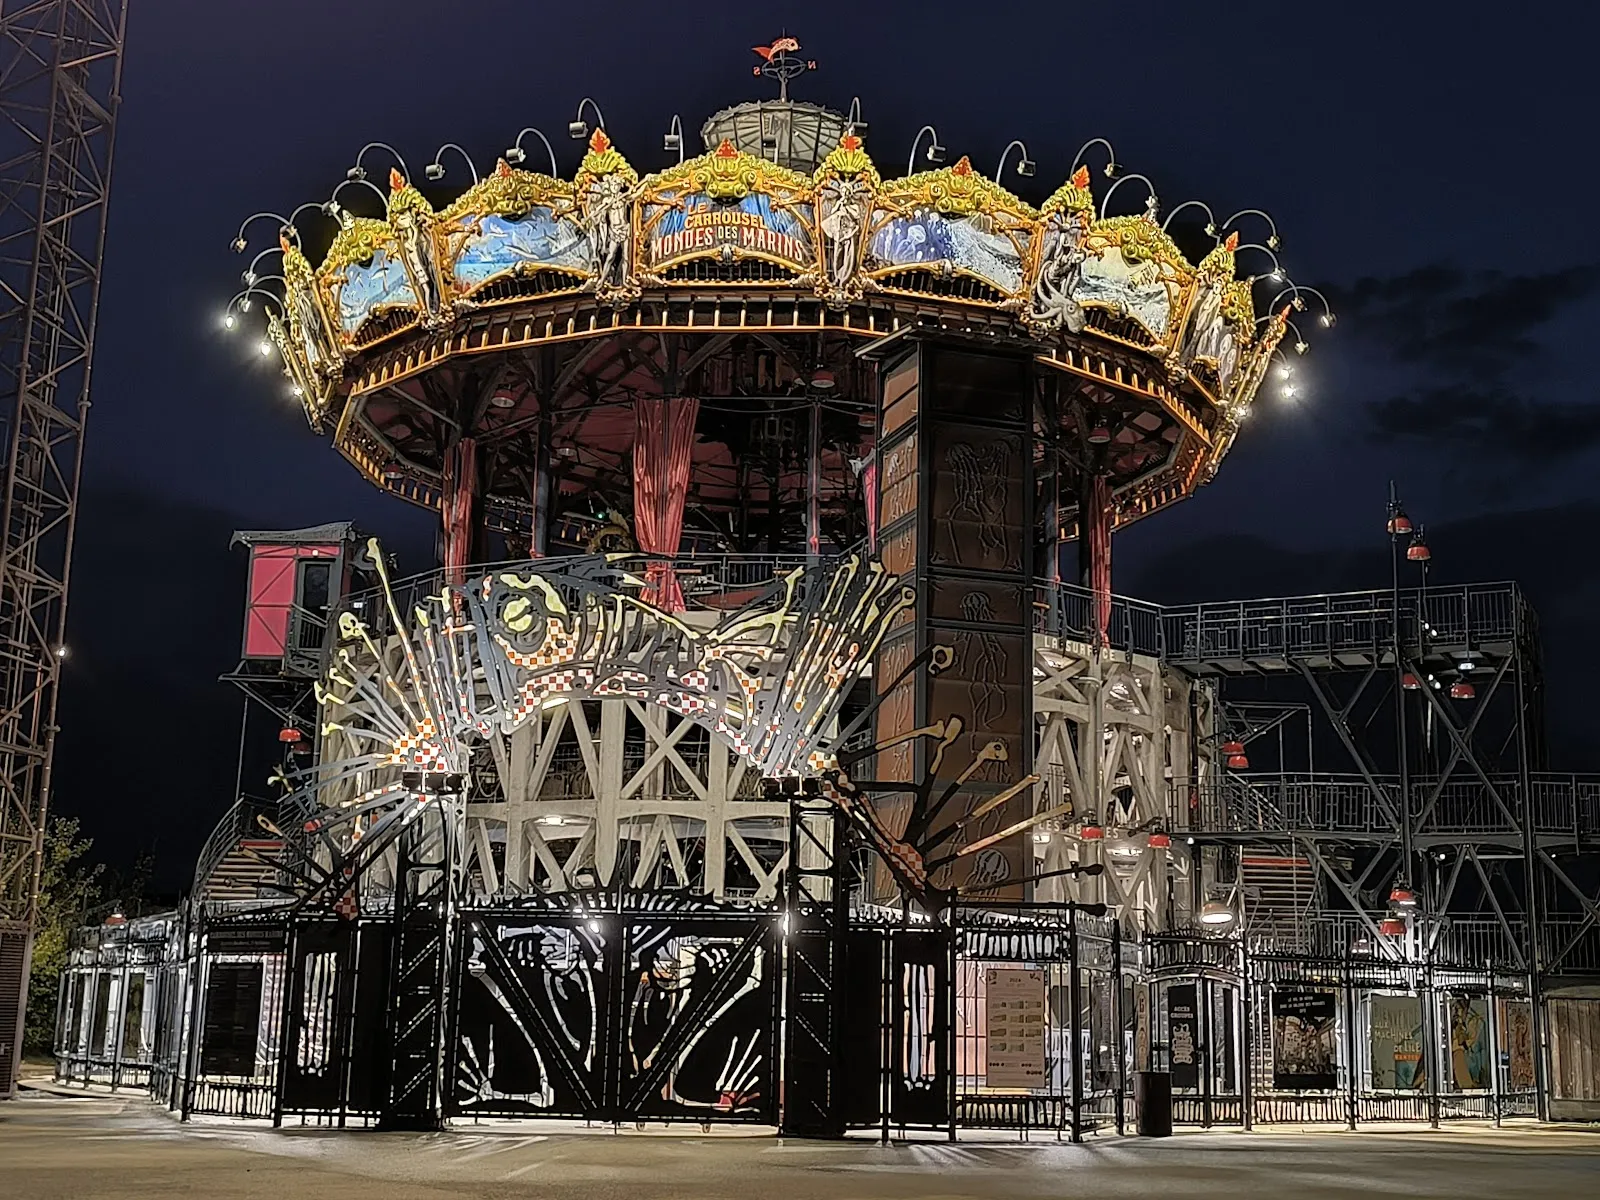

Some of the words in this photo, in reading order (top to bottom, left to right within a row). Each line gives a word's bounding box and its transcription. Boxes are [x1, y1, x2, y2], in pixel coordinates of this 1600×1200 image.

[687, 202, 707, 216] LE
[684, 211, 769, 230] CARROUSEL
[651, 226, 714, 263] MONDES
[717, 225, 739, 240] DES
[742, 226, 804, 262] MARINS
[1044, 636, 1059, 650] LA
[1065, 640, 1116, 661] SURFCE
[1038, 819, 1061, 832] LES
[1375, 1028, 1413, 1044] MACHINES
